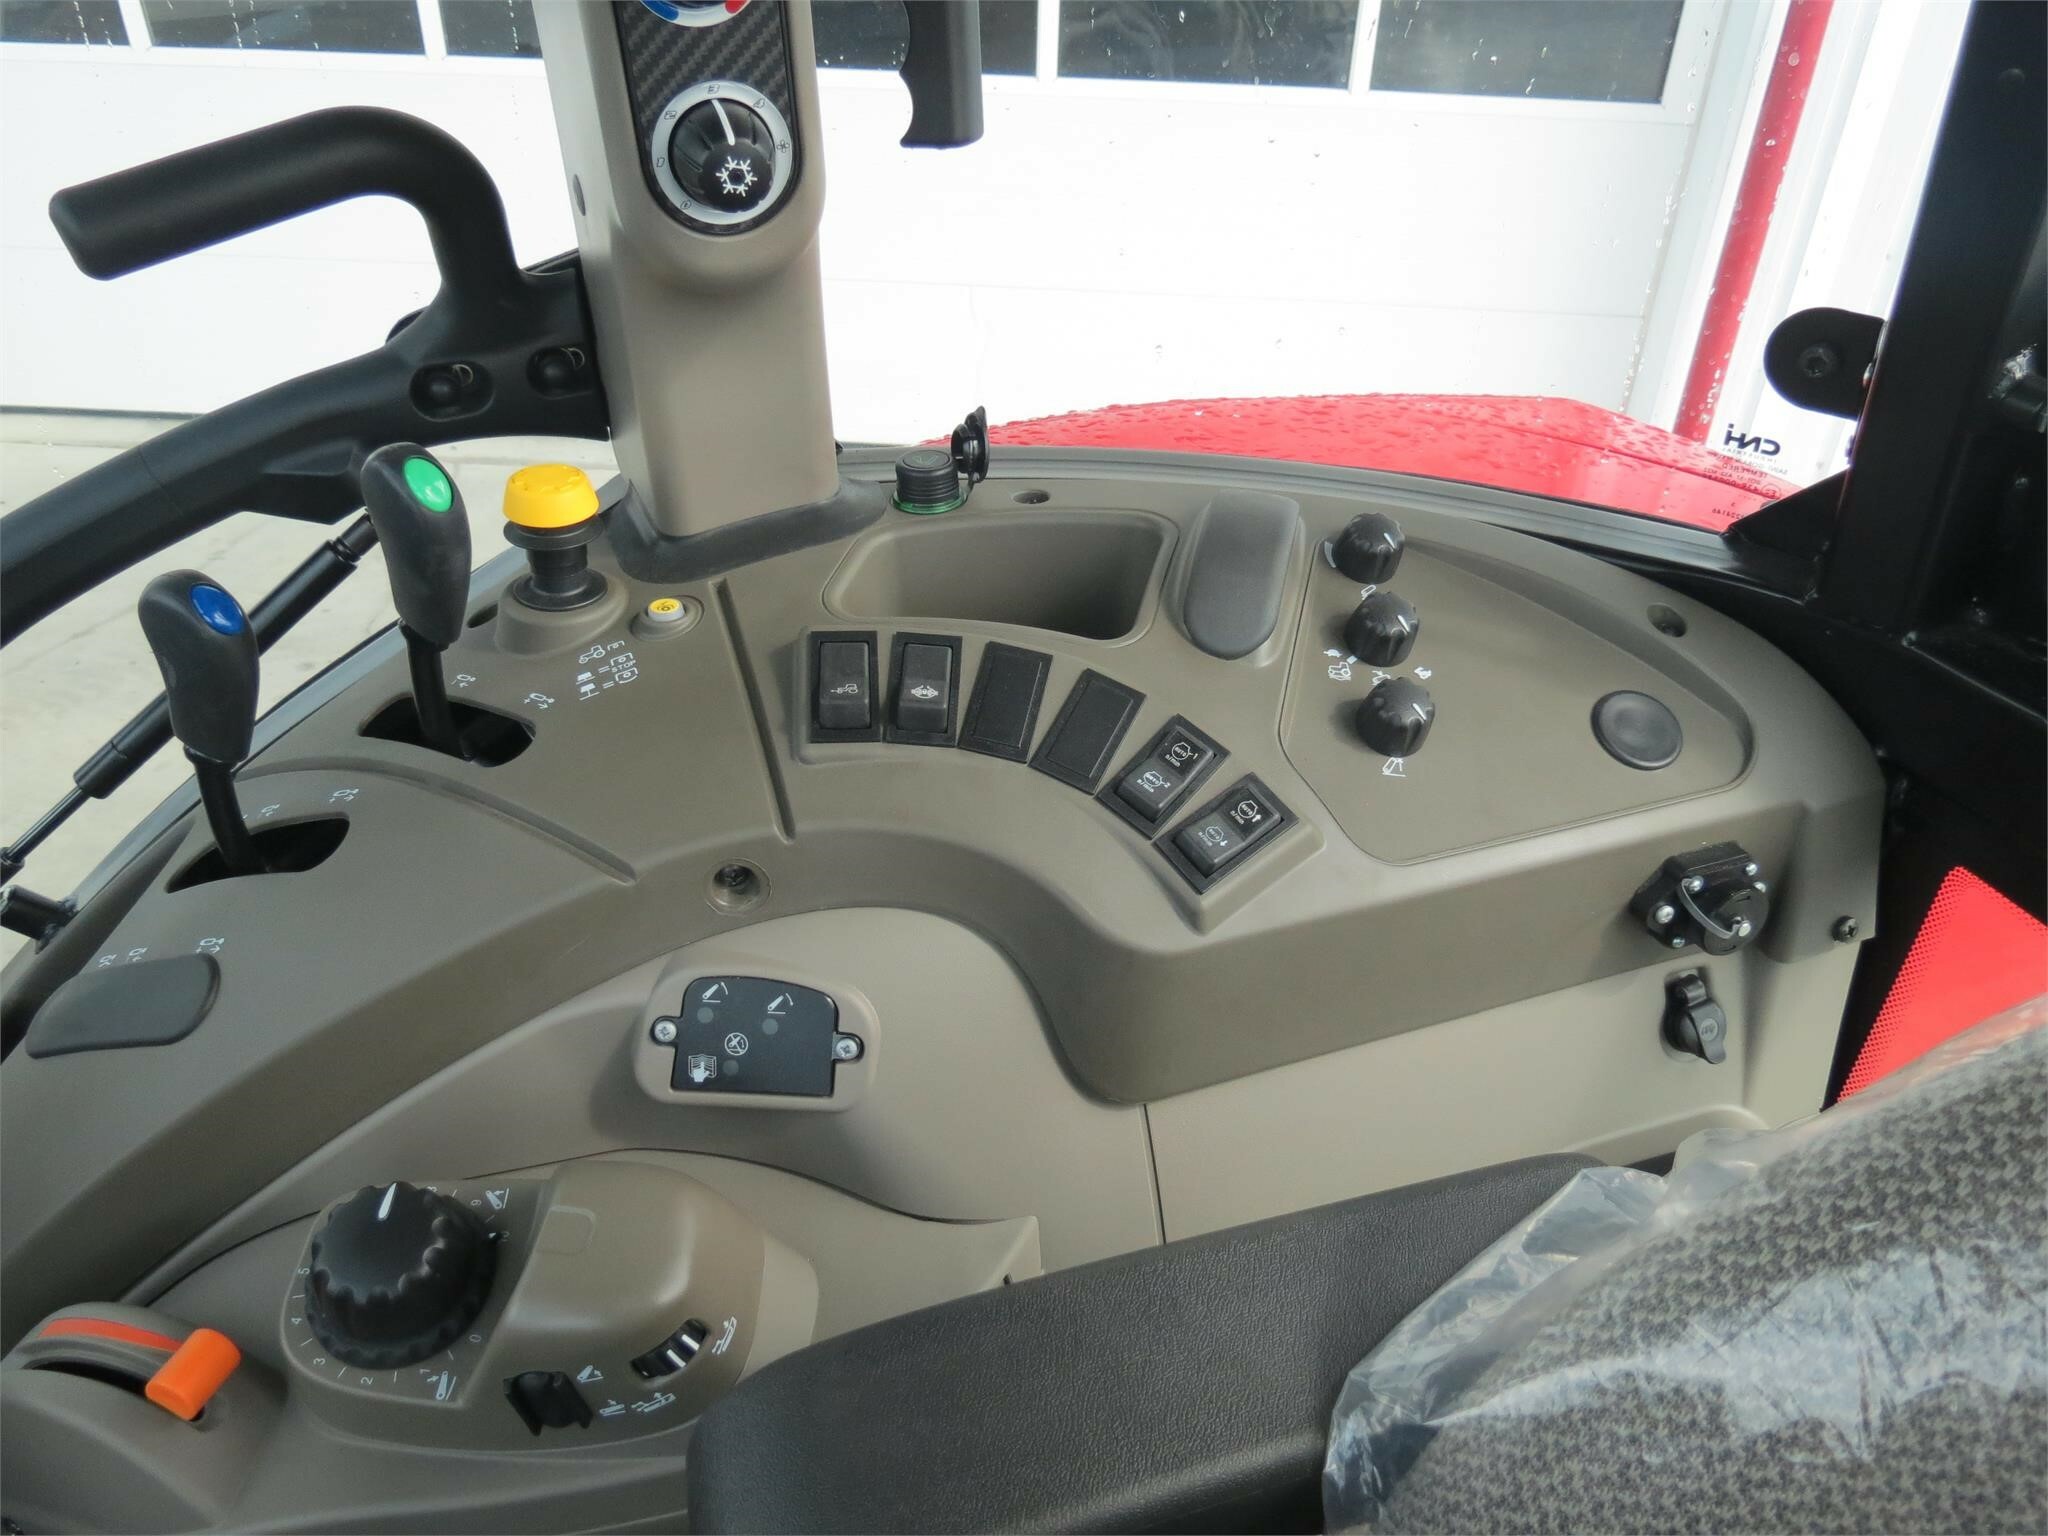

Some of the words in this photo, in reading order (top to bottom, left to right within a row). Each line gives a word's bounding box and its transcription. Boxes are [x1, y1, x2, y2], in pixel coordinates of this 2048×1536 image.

[612, 660, 636, 672] STOP
[298, 1267, 310, 1275] 5
[291, 1317, 302, 1325] 4
[313, 1357, 326, 1366] 3
[360, 1375, 374, 1385] 2
